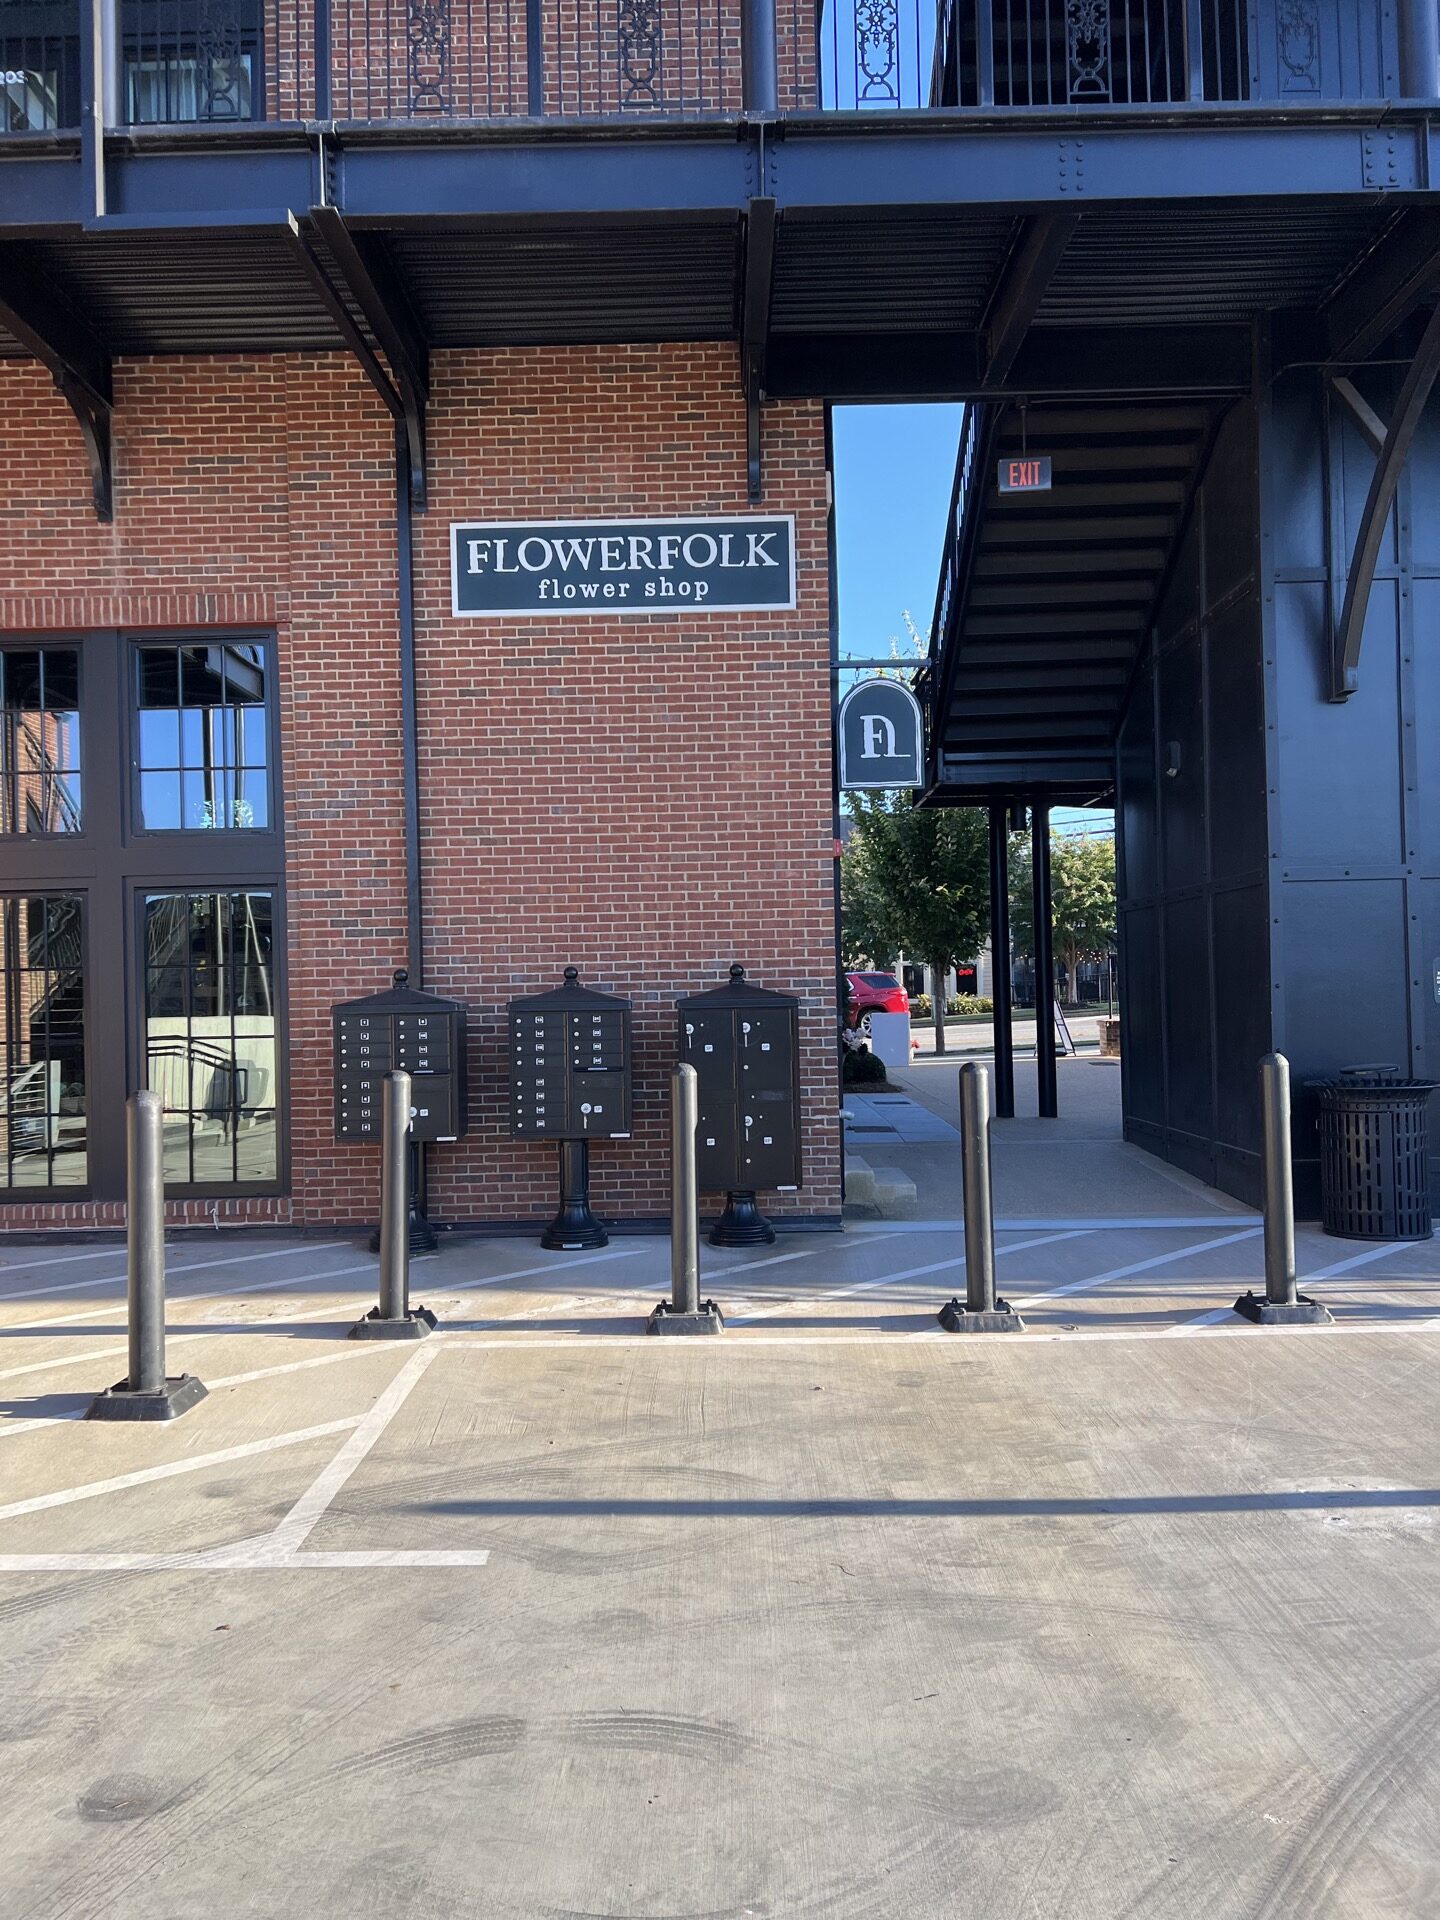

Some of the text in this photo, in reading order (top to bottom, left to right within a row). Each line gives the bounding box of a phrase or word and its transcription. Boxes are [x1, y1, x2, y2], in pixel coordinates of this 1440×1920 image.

[1009, 461, 1041, 487] EXIT
[466, 532, 779, 574] FLOWERFOLK
[538, 576, 709, 600] flower shop
